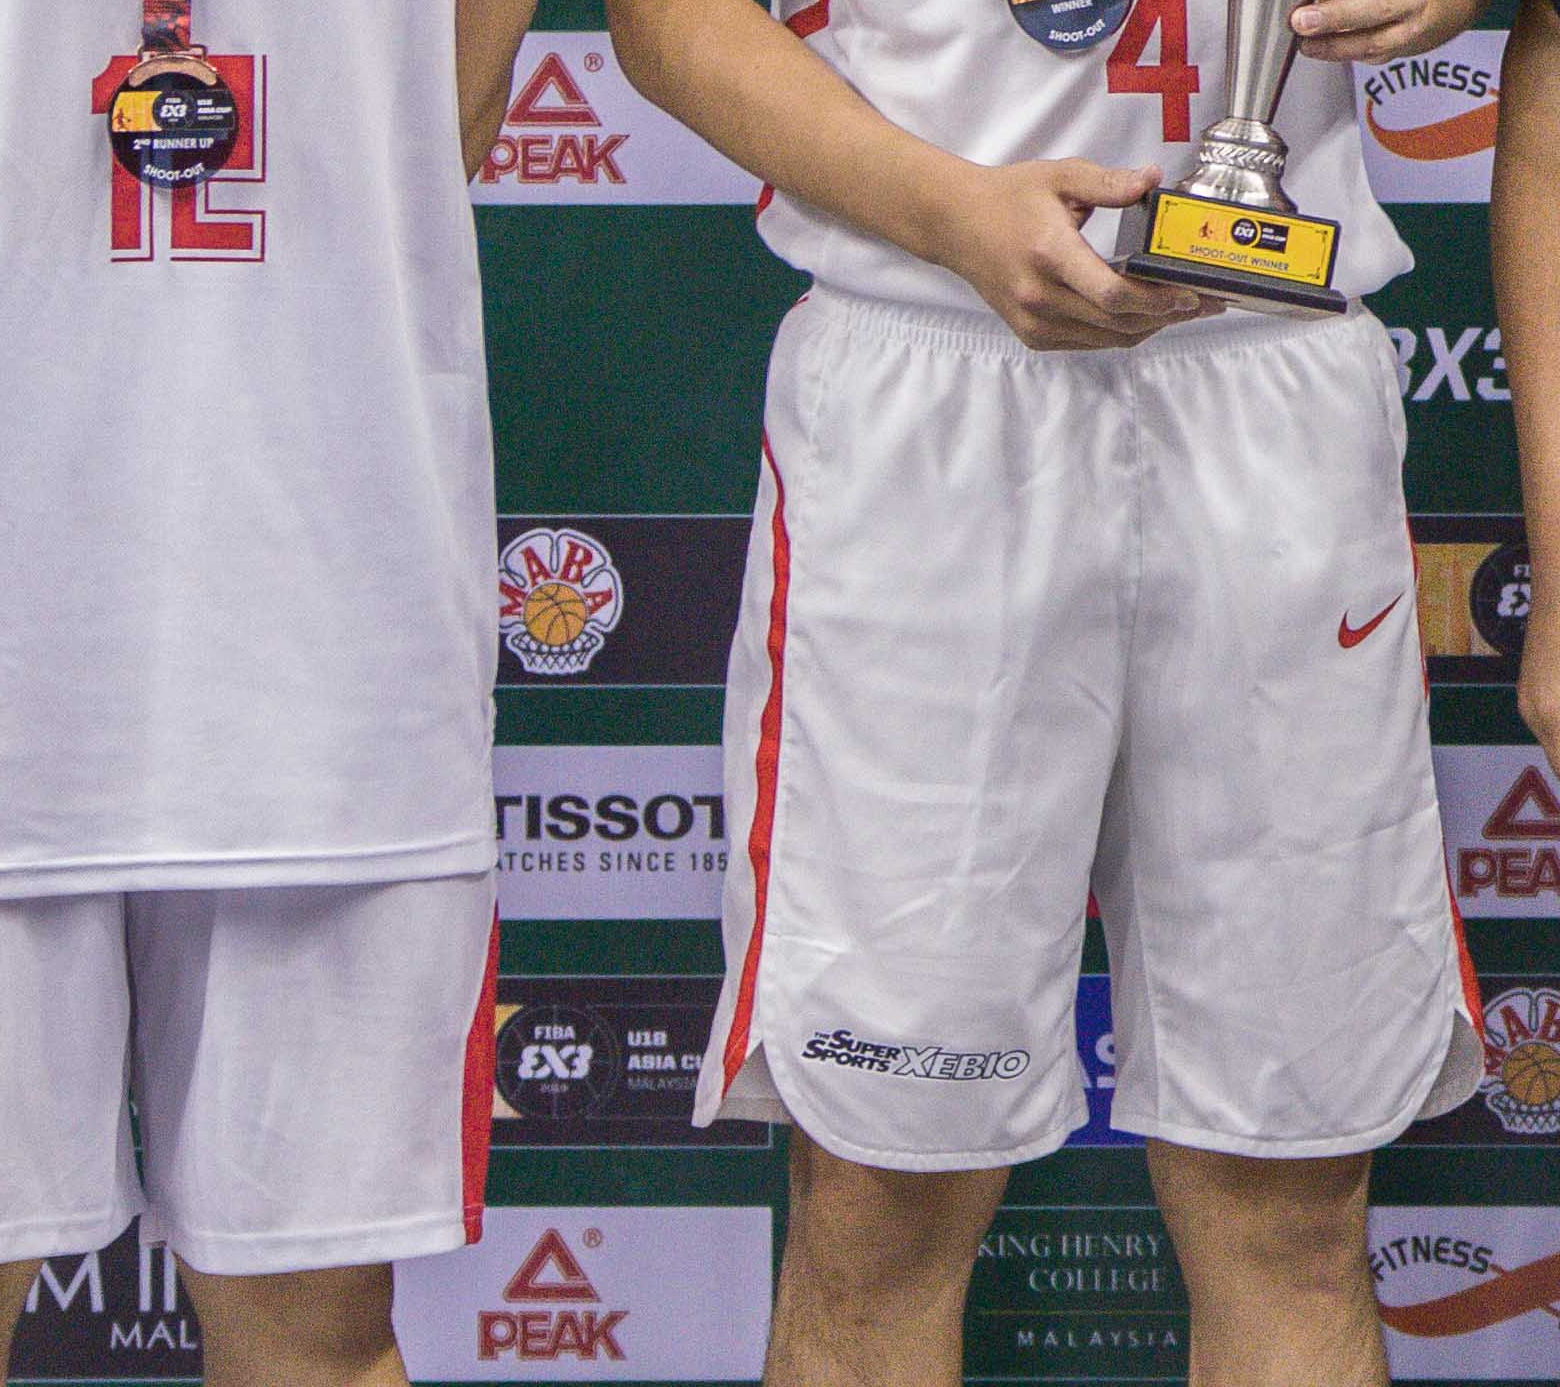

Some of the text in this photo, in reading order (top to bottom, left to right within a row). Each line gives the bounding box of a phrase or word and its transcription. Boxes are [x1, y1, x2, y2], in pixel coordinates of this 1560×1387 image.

[1364, 61, 1492, 103] FITNESS
[893, 1046, 1030, 1080] XEBIO
[480, 1311, 628, 1359] PEAK
